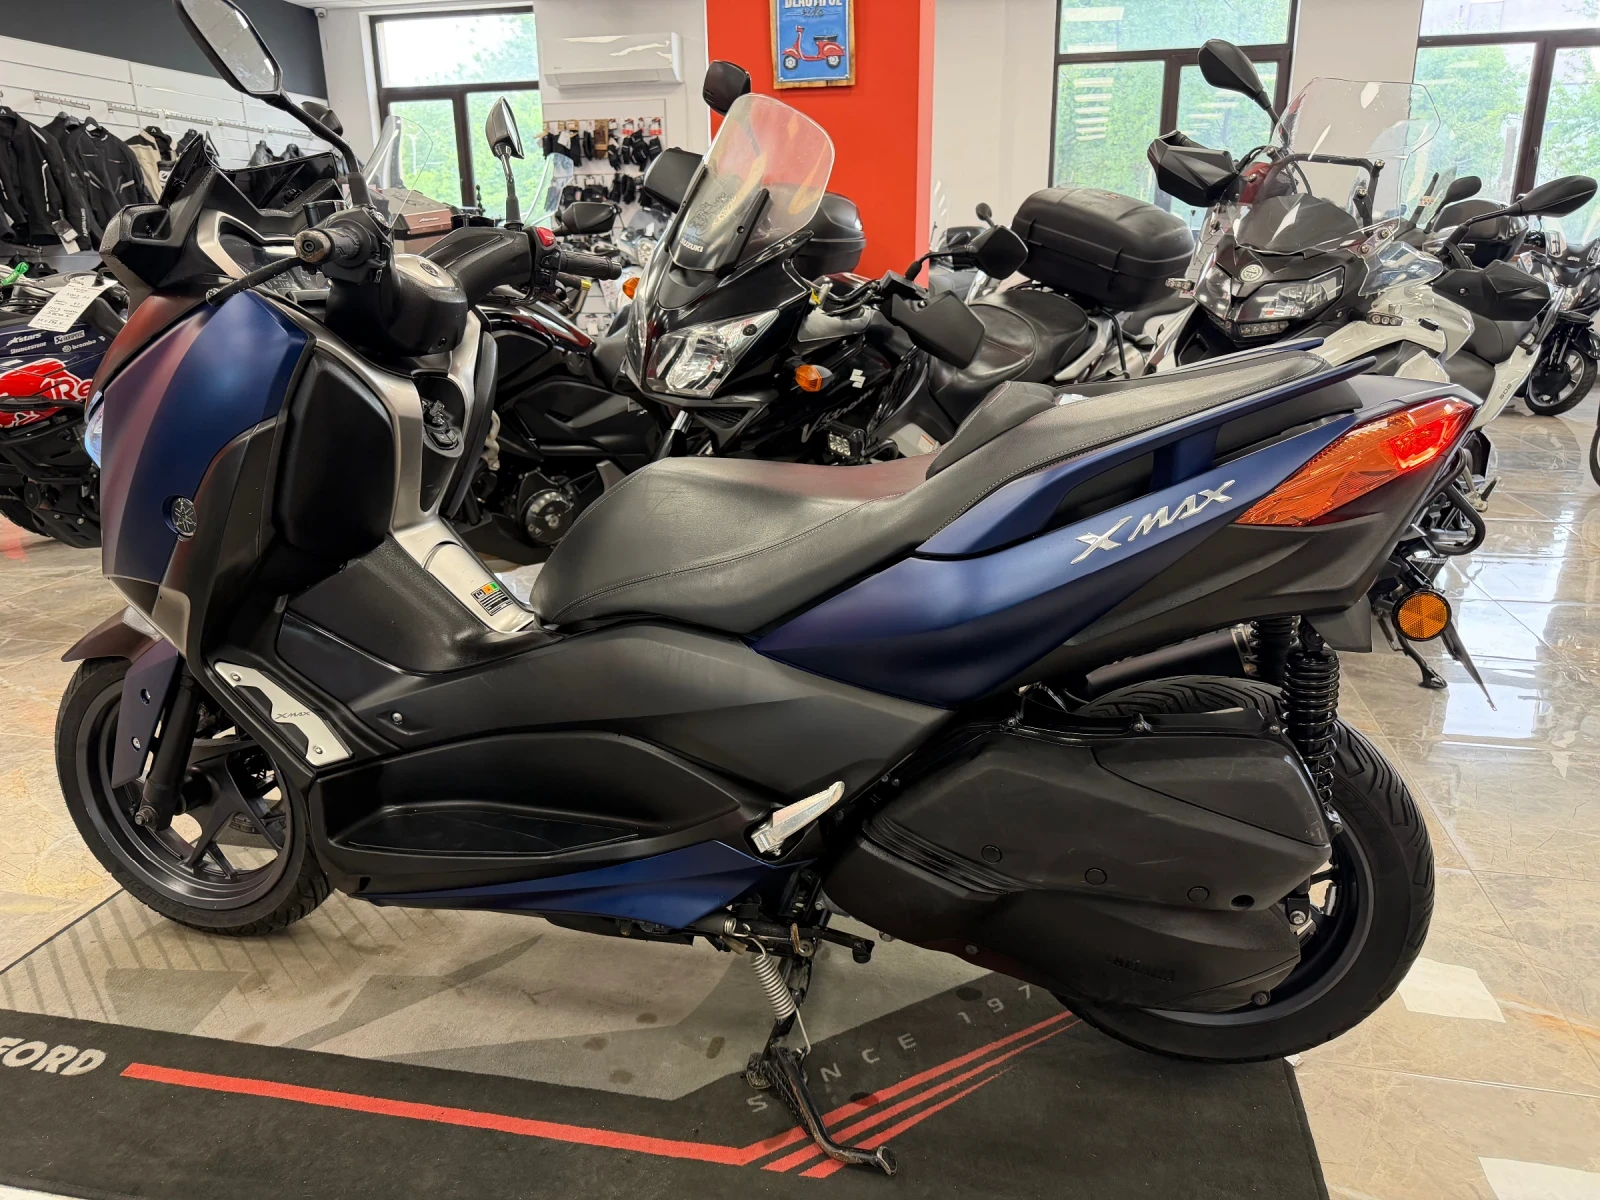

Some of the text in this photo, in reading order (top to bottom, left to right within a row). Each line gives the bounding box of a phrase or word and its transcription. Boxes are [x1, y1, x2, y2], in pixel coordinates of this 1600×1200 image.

[680, 238, 704, 253] SUZUKI
[72, 339, 97, 350] brembo
[746, 984, 1032, 1113] SNCE 197
